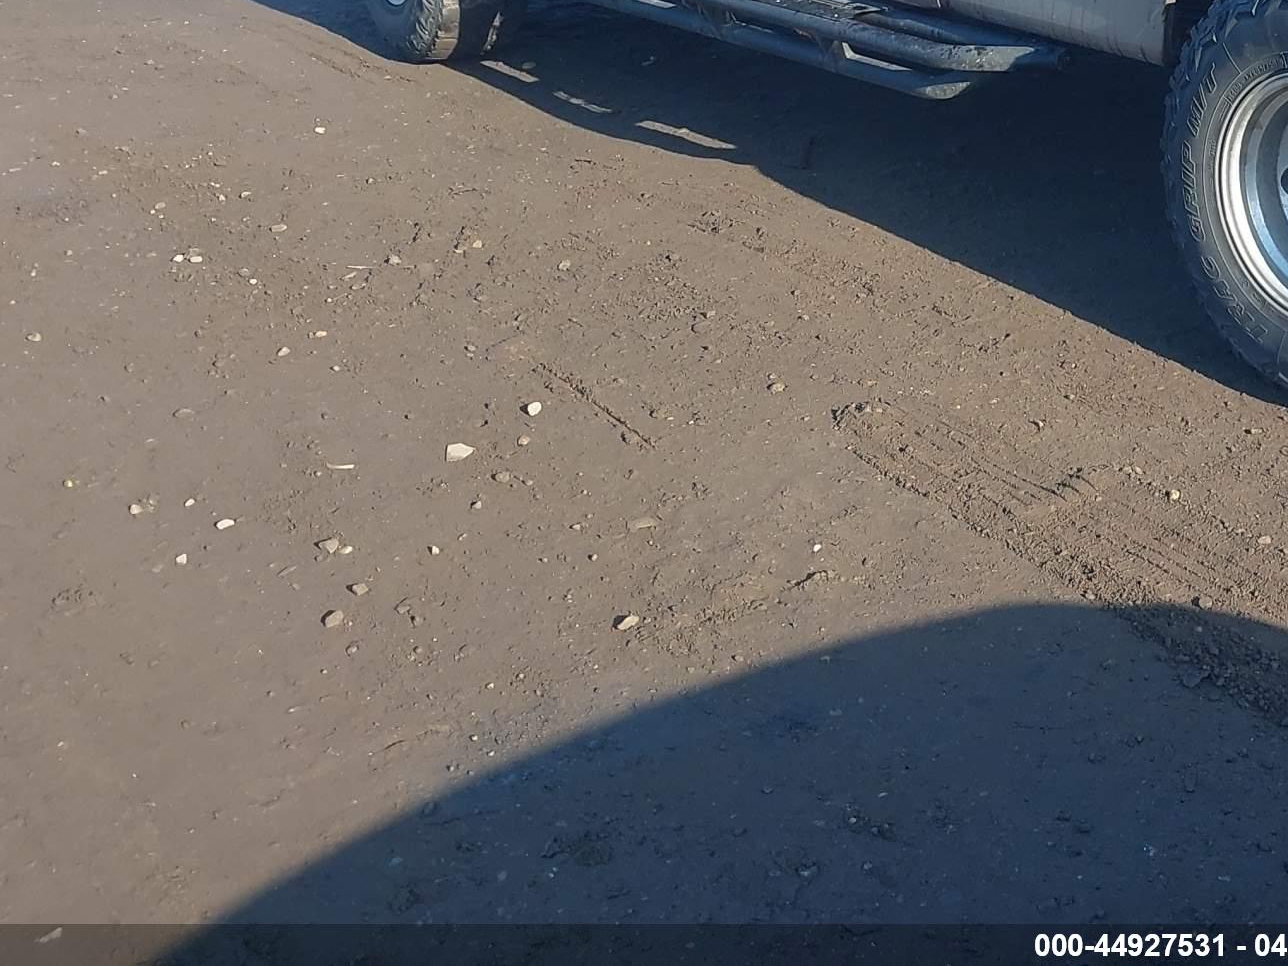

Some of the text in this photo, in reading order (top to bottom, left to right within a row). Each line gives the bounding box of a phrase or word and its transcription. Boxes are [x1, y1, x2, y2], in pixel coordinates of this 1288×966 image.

[1186, 61, 1218, 137] M/T
[1181, 140, 1207, 244] GRIP
[1199, 254, 1269, 345] TRAC
